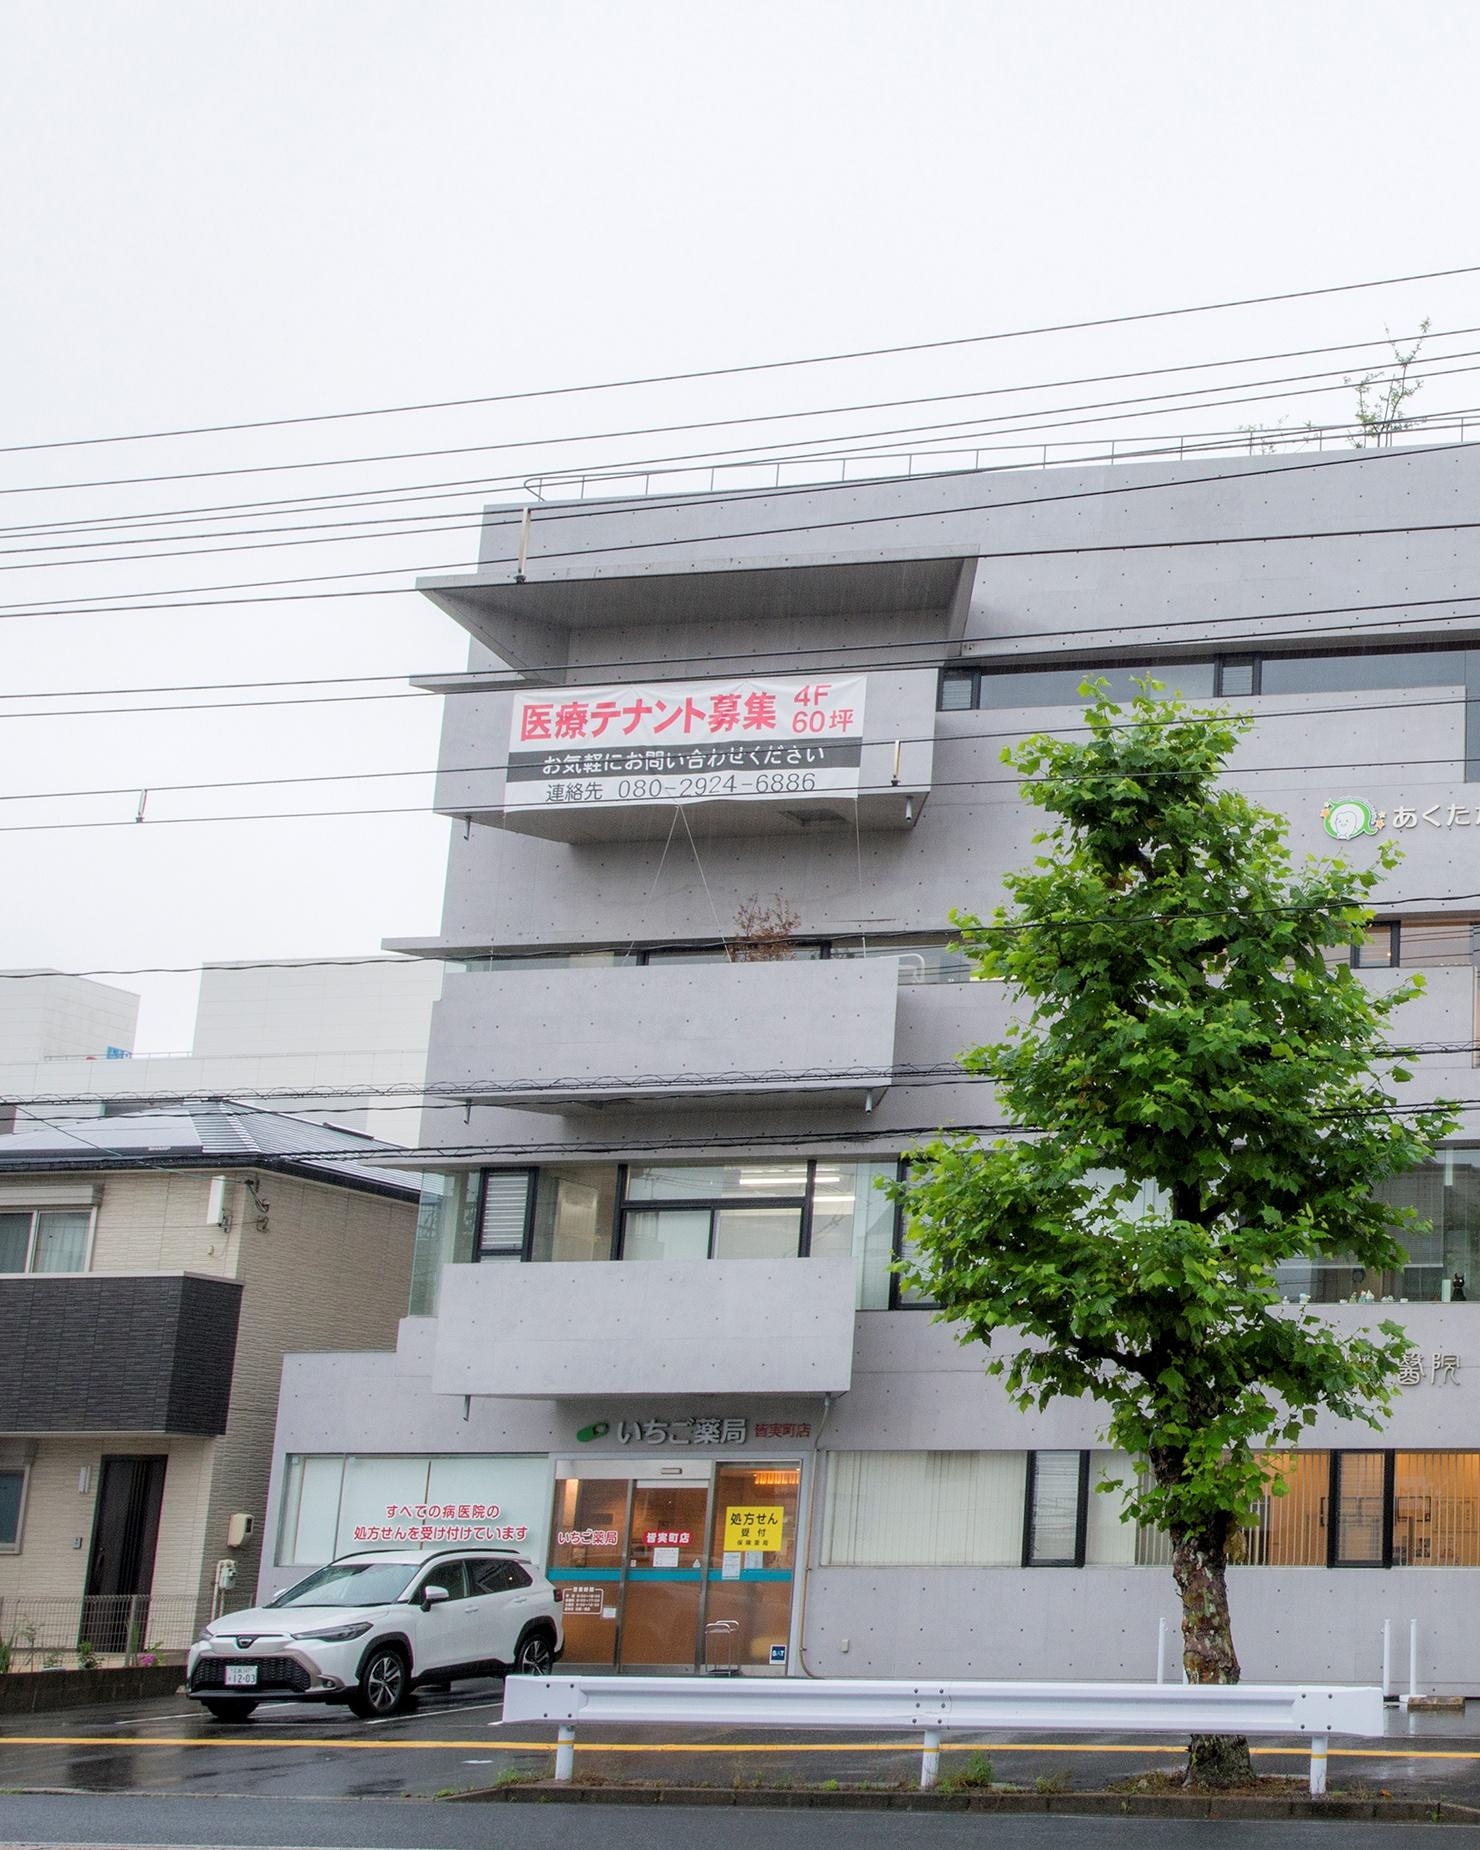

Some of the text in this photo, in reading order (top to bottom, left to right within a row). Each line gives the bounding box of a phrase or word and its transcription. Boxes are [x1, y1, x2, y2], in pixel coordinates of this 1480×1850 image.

[793, 685, 832, 707] 4F
[520, 692, 777, 742] 医療テナント募集
[792, 709, 854, 734] 60坪
[542, 745, 825, 775] お気軽にお問い合わせください
[546, 772, 816, 803] 連絡先 080-2924-6886
[616, 1418, 811, 1445] いちご薬局 皆実町店
[385, 1504, 501, 1520] すべての病医院の
[730, 1512, 778, 1526] 処方せん
[353, 1525, 529, 1542] 処方せんを受け付けています
[557, 1530, 618, 1545] いちご薬局
[646, 1532, 690, 1544] 皆実町店
[233, 1674, 255, 1683] 12-03
